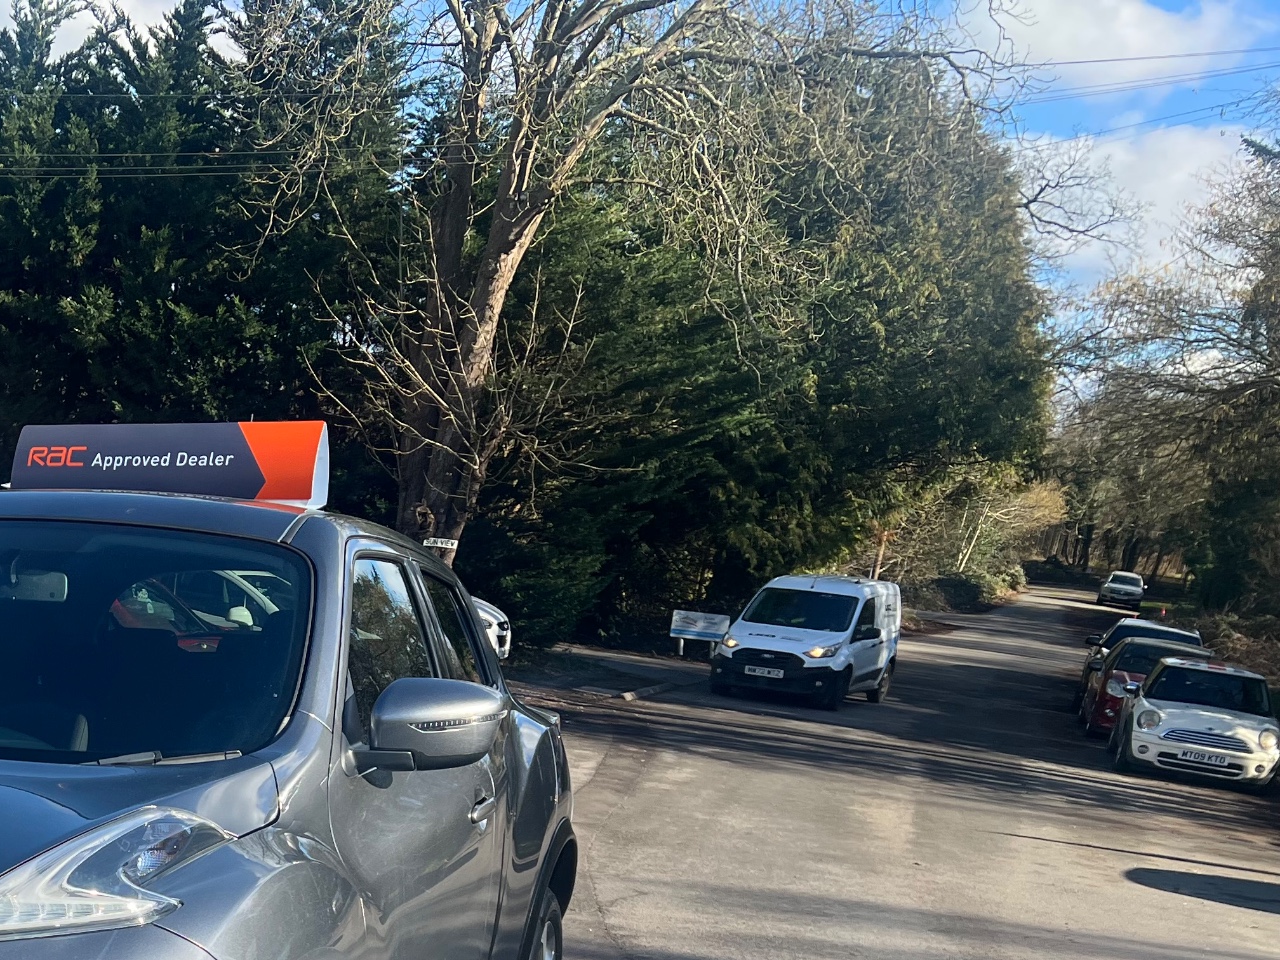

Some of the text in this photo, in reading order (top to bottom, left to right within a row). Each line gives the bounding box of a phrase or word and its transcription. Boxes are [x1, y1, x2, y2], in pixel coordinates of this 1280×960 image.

[91, 452, 170, 470] Approved
[176, 451, 235, 467] Dealer
[1181, 750, 1206, 761] MT09
